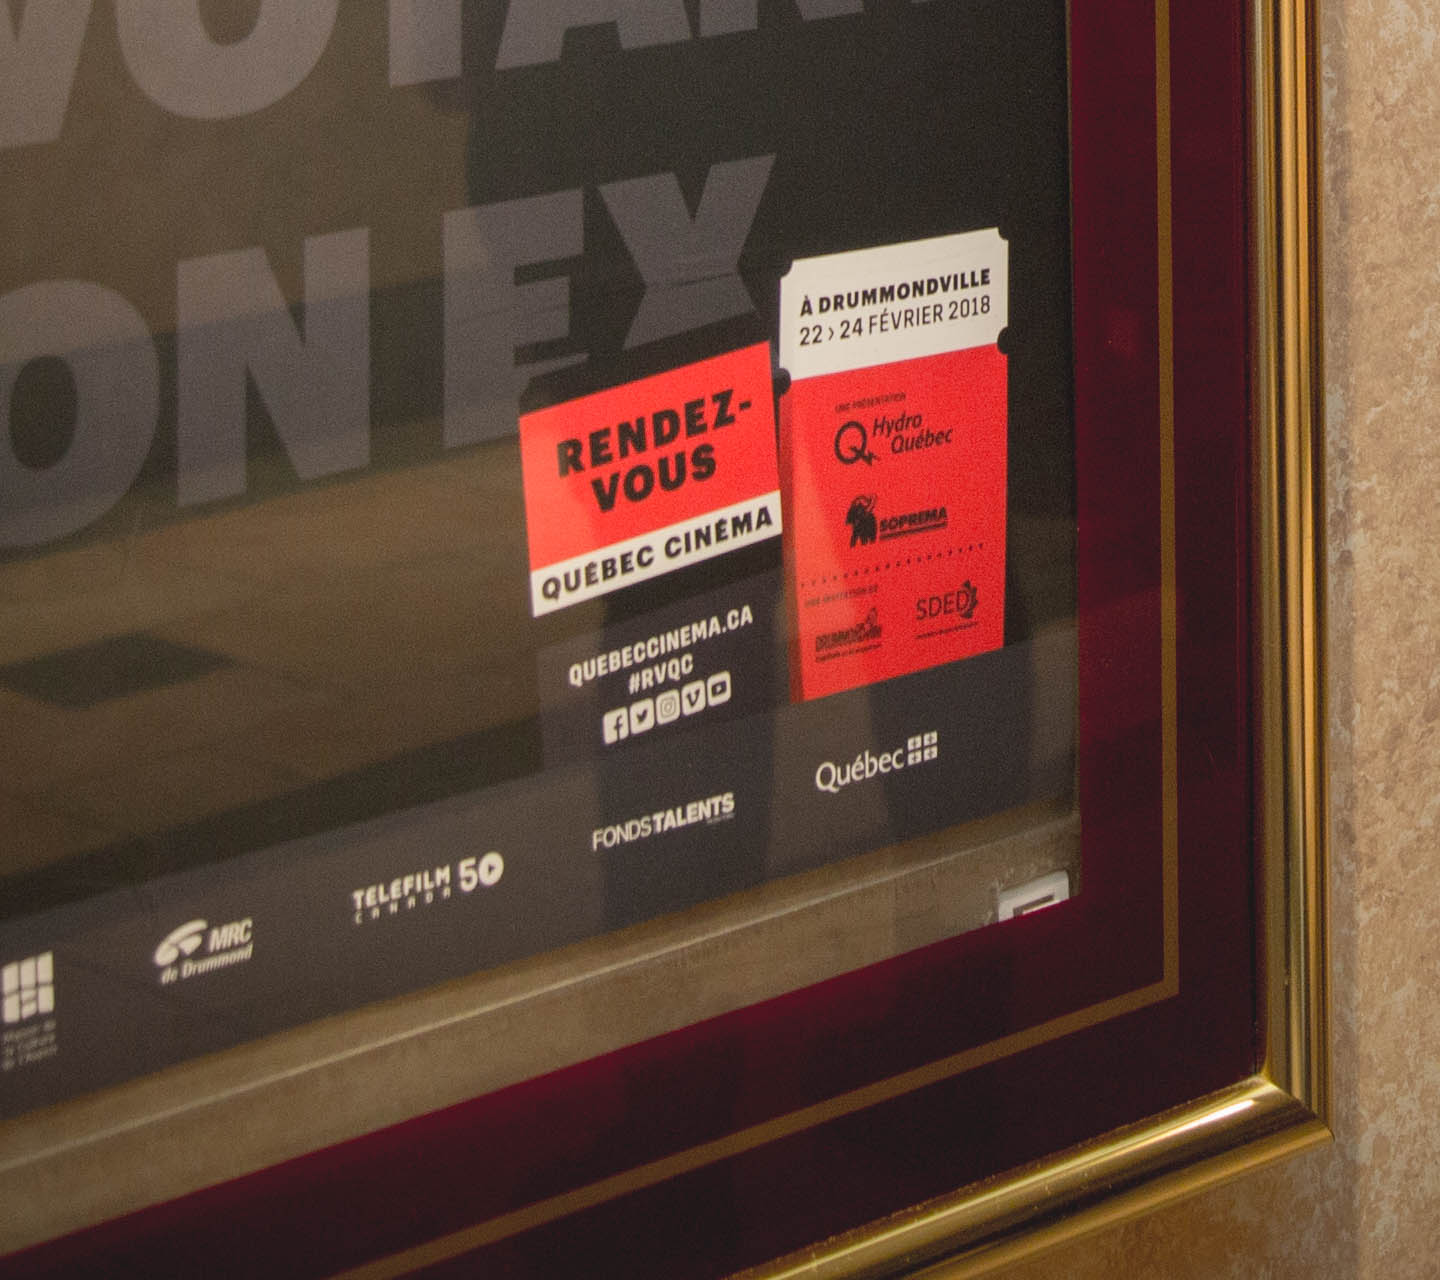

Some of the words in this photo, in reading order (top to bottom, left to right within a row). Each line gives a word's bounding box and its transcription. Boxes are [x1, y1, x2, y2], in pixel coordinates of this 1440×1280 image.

[441, 151, 779, 452] EX
[799, 295, 814, 318] À
[818, 267, 991, 316] DRUMMONDVILLE
[799, 324, 823, 347] 22
[839, 317, 864, 341] 24
[868, 303, 944, 335] FÉVRIER
[948, 294, 991, 321] 2018
[556, 389, 753, 479] RENDEZ-
[872, 411, 923, 439] Hydro
[890, 427, 954, 455] Québec
[590, 443, 717, 513] VOUS
[879, 506, 948, 533] SOPREMA
[541, 545, 656, 601] QUÉBEC
[663, 506, 773, 560] CINÉMA
[915, 589, 971, 621] SDED
[568, 603, 754, 688] QUEBECCINEMA.CA
[628, 653, 694, 695] #RVQC
[815, 745, 906, 794] Québec
[351, 864, 451, 911] TELEFILM
[458, 850, 505, 893] 50
[354, 885, 452, 925] CANADA
[208, 916, 254, 954] MRC
[181, 942, 254, 978] Drummond
